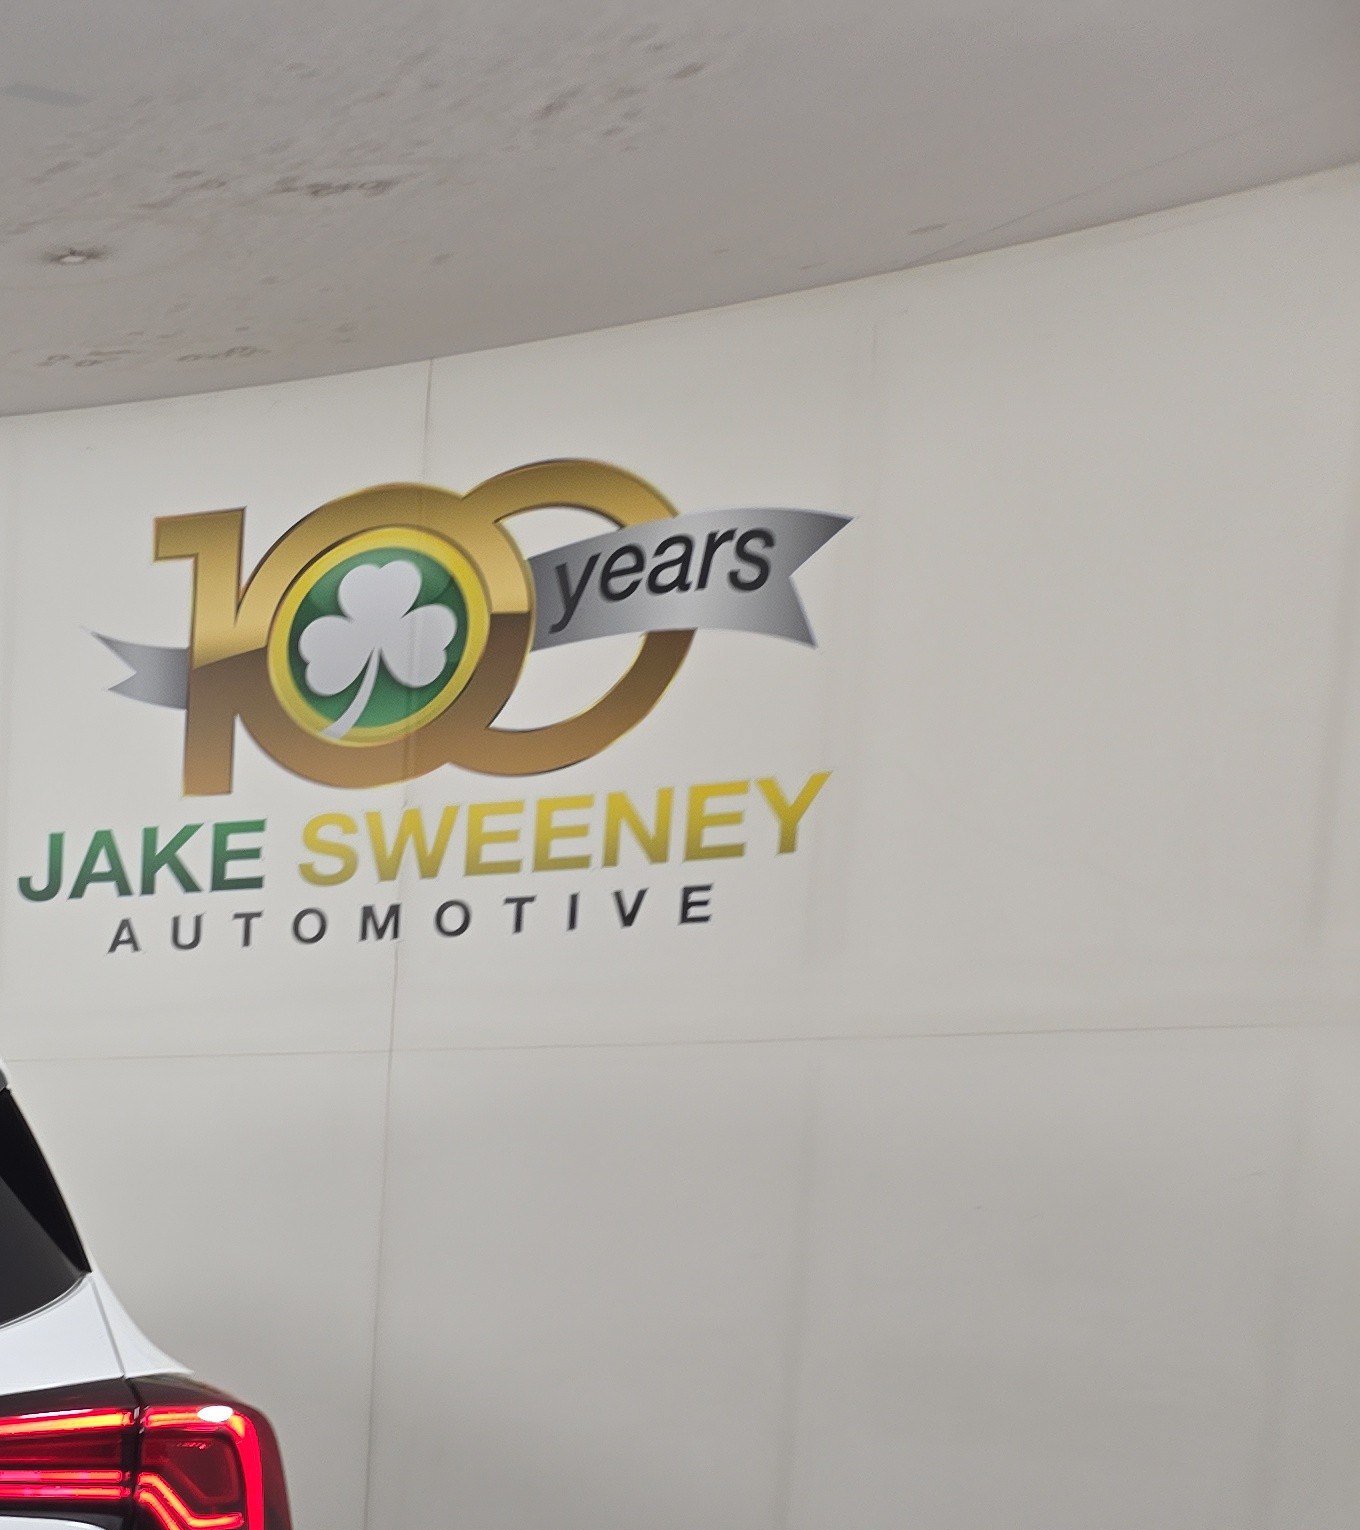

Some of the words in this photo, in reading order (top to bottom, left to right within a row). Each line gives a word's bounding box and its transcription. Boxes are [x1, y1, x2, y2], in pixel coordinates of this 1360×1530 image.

[548, 523, 776, 635] years
[18, 817, 268, 903] JAKE
[297, 770, 833, 887] SWEENEY
[107, 883, 714, 955] AUTOMOTIVE
